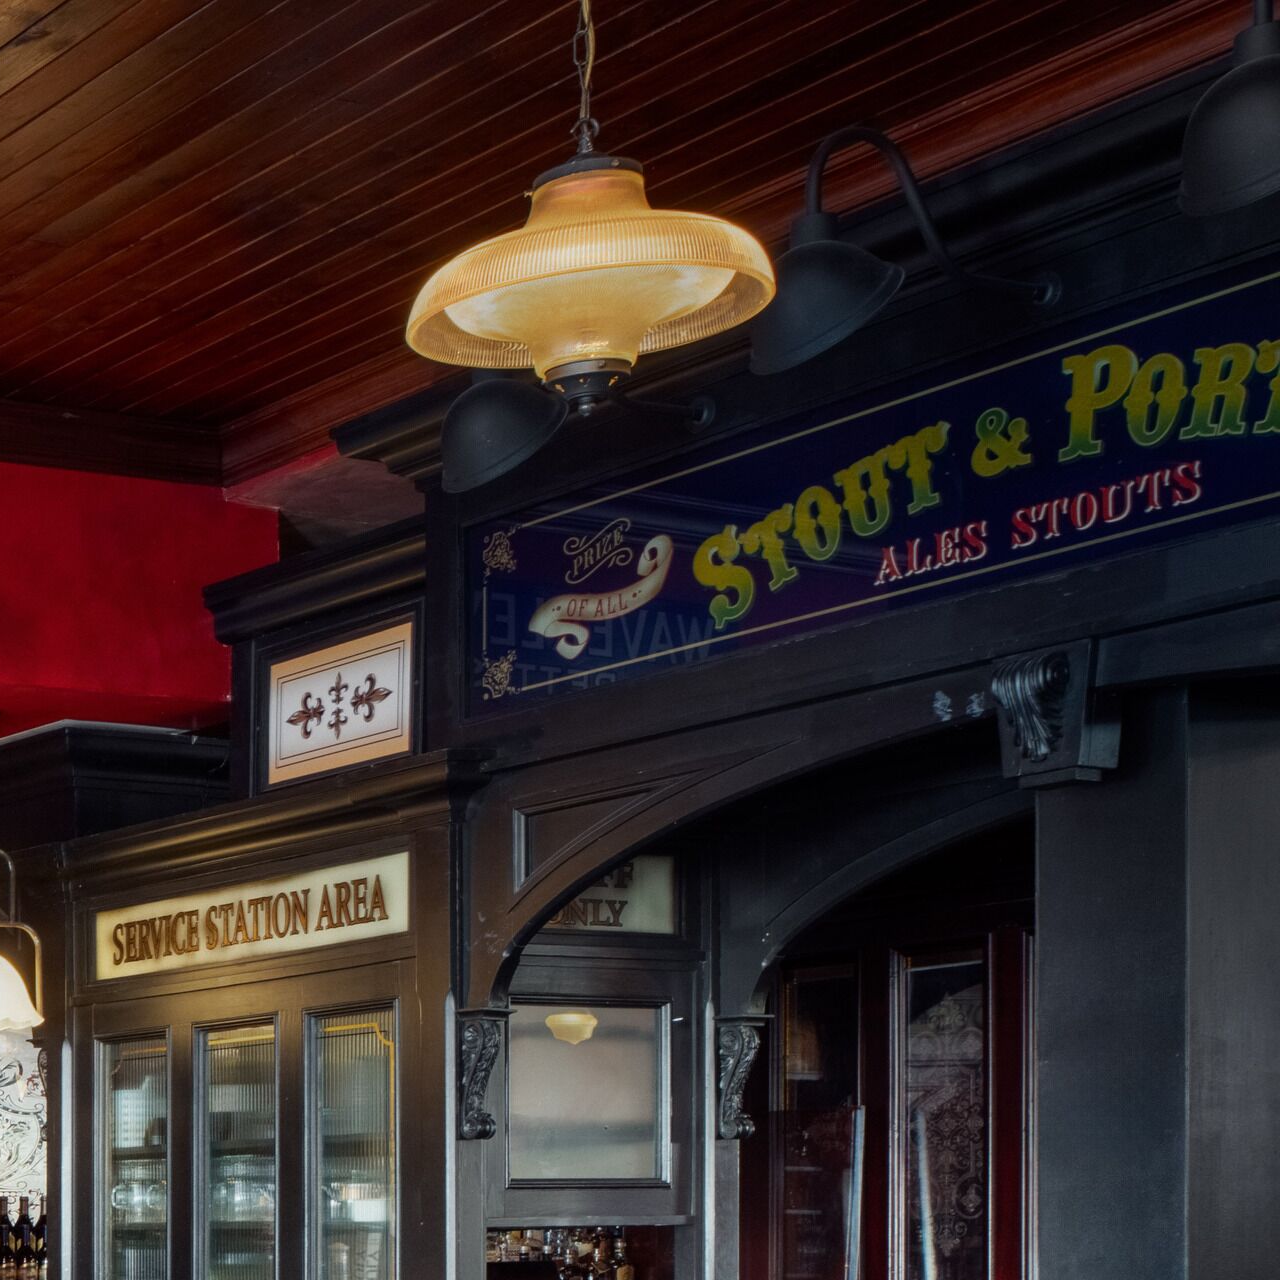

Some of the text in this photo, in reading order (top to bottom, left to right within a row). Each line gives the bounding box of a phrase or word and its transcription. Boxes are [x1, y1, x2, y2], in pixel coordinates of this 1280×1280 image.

[572, 529, 624, 578] PRIZE
[692, 420, 952, 630] STOUT
[970, 406, 1033, 478] &
[873, 460, 1203, 586] ALES STOUTS
[566, 593, 628, 618] OF ALL
[112, 874, 389, 966] SERVICE STATION AREA
